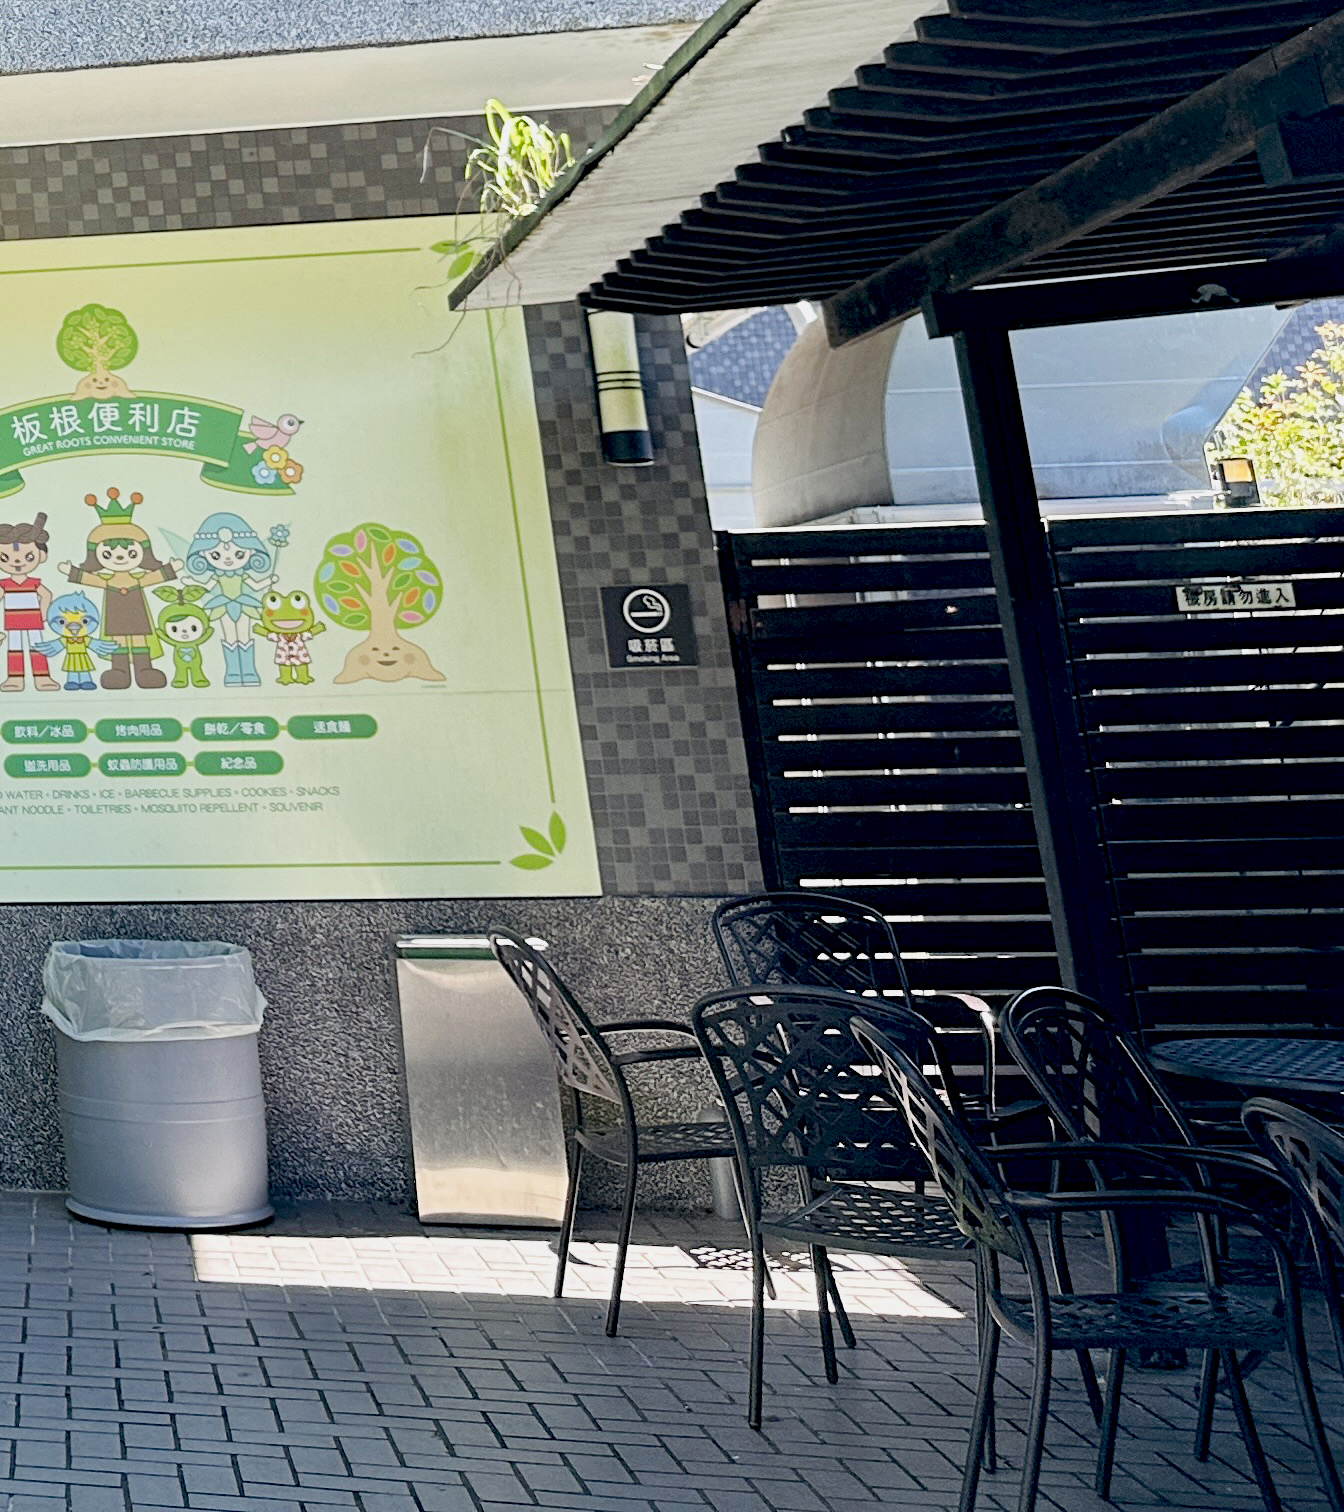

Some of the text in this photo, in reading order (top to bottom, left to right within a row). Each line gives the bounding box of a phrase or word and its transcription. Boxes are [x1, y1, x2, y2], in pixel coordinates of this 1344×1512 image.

[10, 402, 202, 446] 板根便利店
[22, 434, 196, 457] GREAT ROOTS CONVENIENT STORE
[115, 723, 163, 737] 烤肉用品
[220, 756, 257, 770] 紀念品
[5, 790, 44, 800] WATER
[51, 789, 90, 799] DRINKS
[99, 789, 115, 799] ICE
[124, 788, 180, 799] BARBECUE
[183, 787, 232, 798] SUPPLIES
[241, 787, 287, 797] COOKIES
[295, 786, 341, 796] SNACKS
[22, 805, 64, 815] NOODLE
[74, 804, 132, 814] TOILETRIES
[140, 804, 197, 814] MOSQUITO
[200, 803, 260, 813] REPELLENT
[269, 802, 324, 812] SOUVENIR
